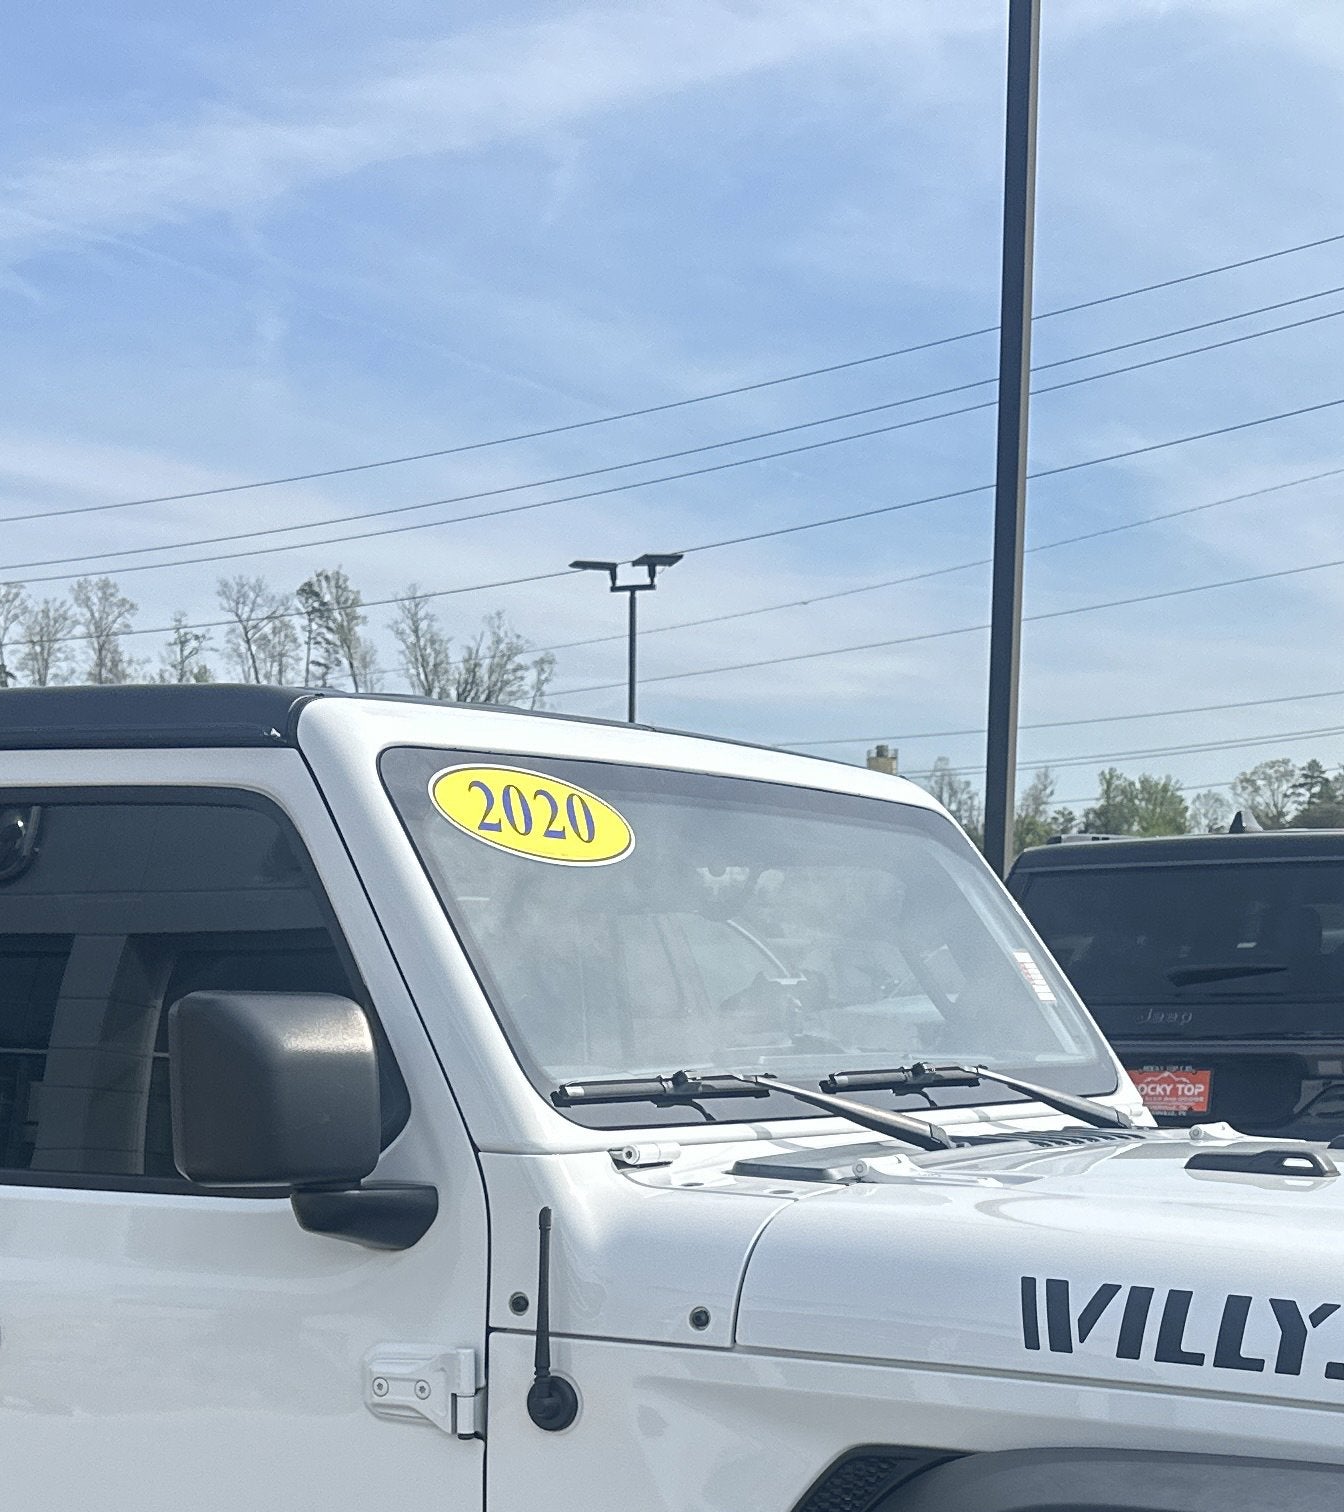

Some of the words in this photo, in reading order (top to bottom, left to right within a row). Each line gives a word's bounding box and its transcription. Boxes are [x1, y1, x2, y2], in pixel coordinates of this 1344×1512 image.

[468, 780, 595, 843] 2020
[1137, 1084, 1173, 1095] OCKY
[1176, 1084, 1204, 1096] TOP
